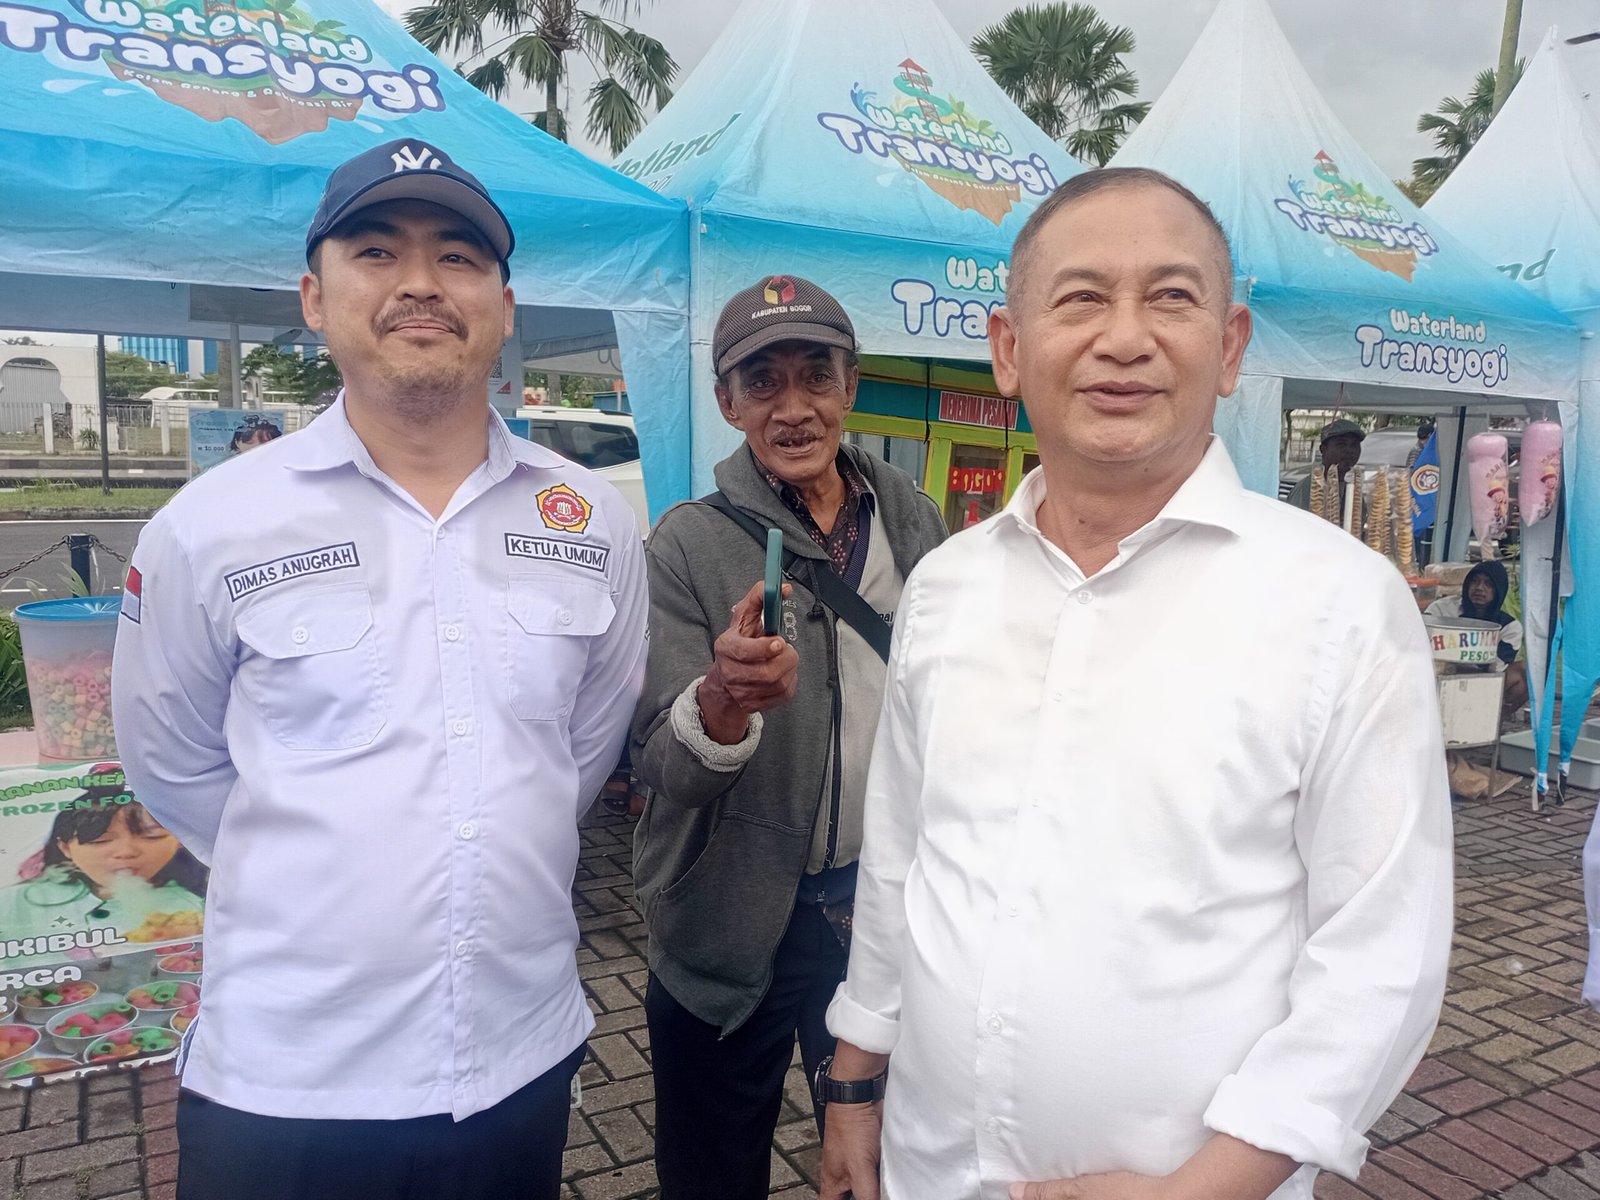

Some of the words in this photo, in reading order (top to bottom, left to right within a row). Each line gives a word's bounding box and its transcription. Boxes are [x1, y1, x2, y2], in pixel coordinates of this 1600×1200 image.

[0, 3, 446, 112] Transyogi
[817, 112, 1058, 195] Transyogi
[866, 104, 1013, 155] Waterland
[1274, 198, 1439, 256] Transyogi
[751, 305, 788, 320] KABUPATEN
[1389, 308, 1487, 343] Waterland
[1355, 324, 1508, 388] Transyogi
[232, 566, 278, 595] DIMAS
[281, 548, 353, 577] ANUGRAH
[510, 538, 562, 558] KETUA
[564, 545, 604, 567] UMUM
